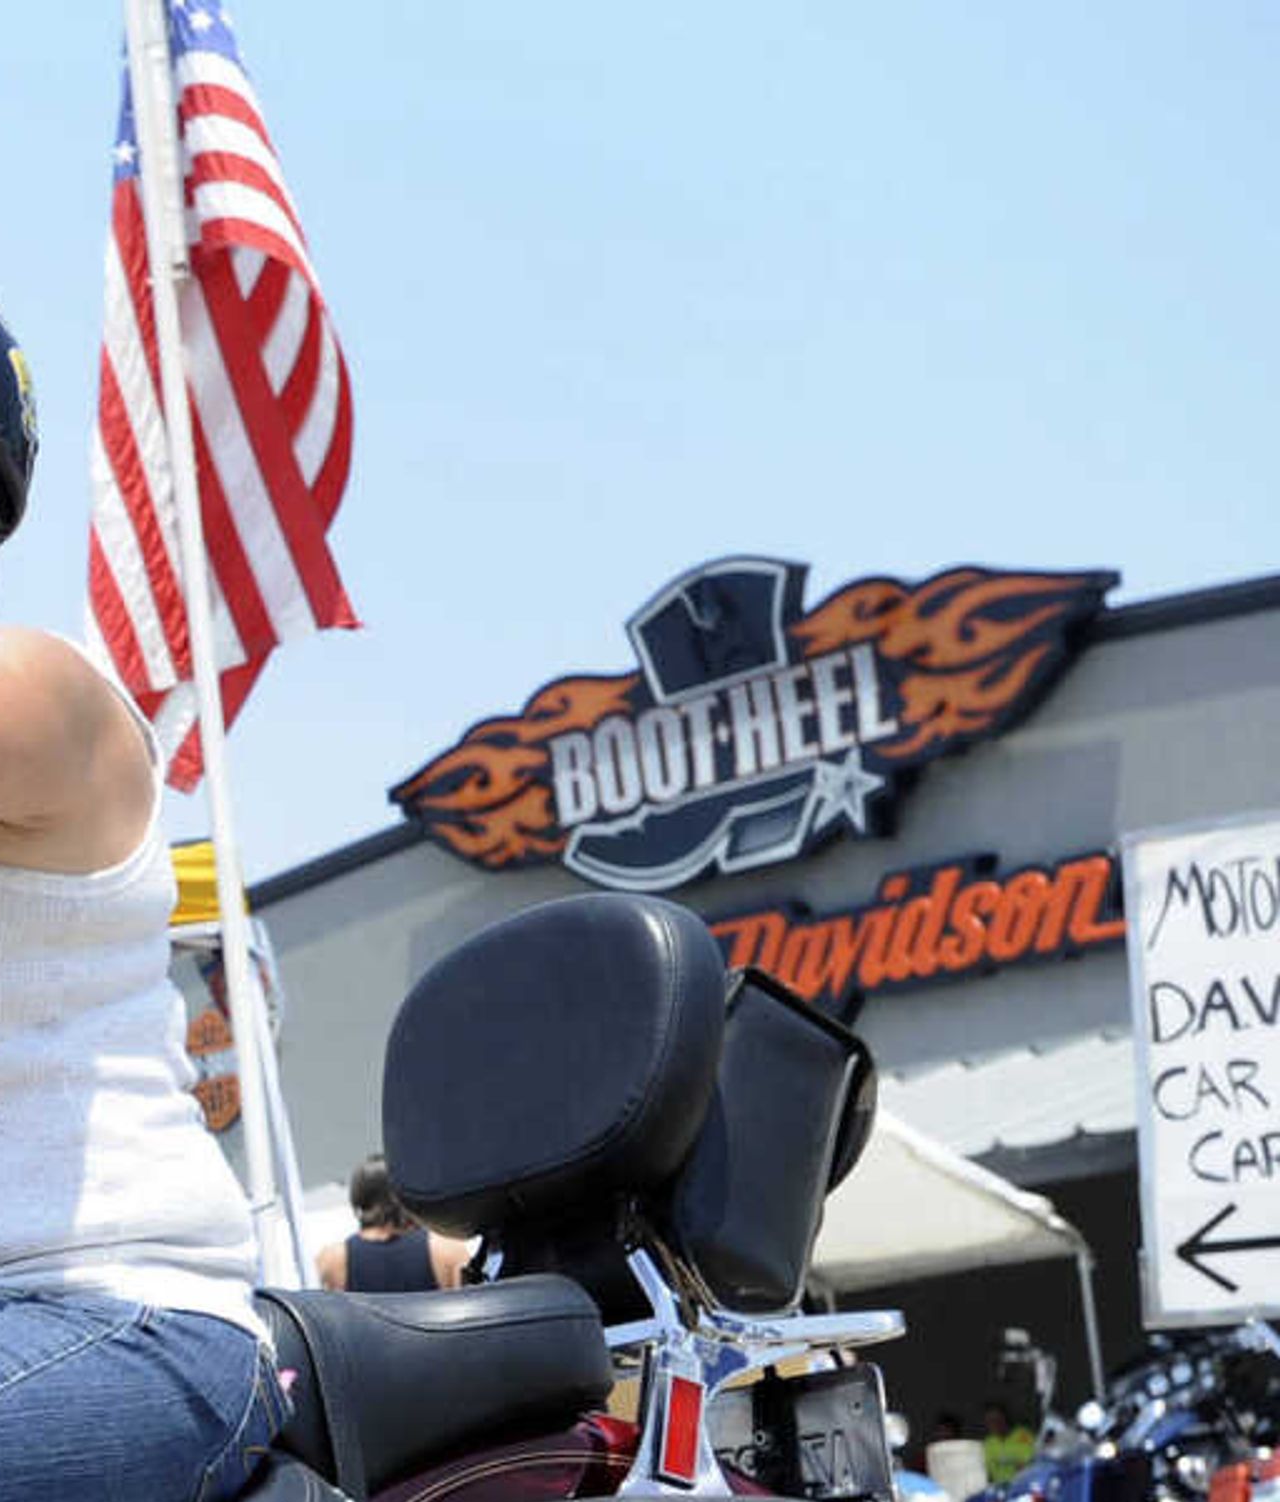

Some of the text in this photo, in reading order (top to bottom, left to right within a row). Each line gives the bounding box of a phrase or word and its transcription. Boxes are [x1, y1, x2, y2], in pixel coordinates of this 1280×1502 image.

[710, 855, 1127, 1000] Davidson
[1148, 857, 1280, 947] MOTO
[1153, 1059, 1270, 1121] CAR
